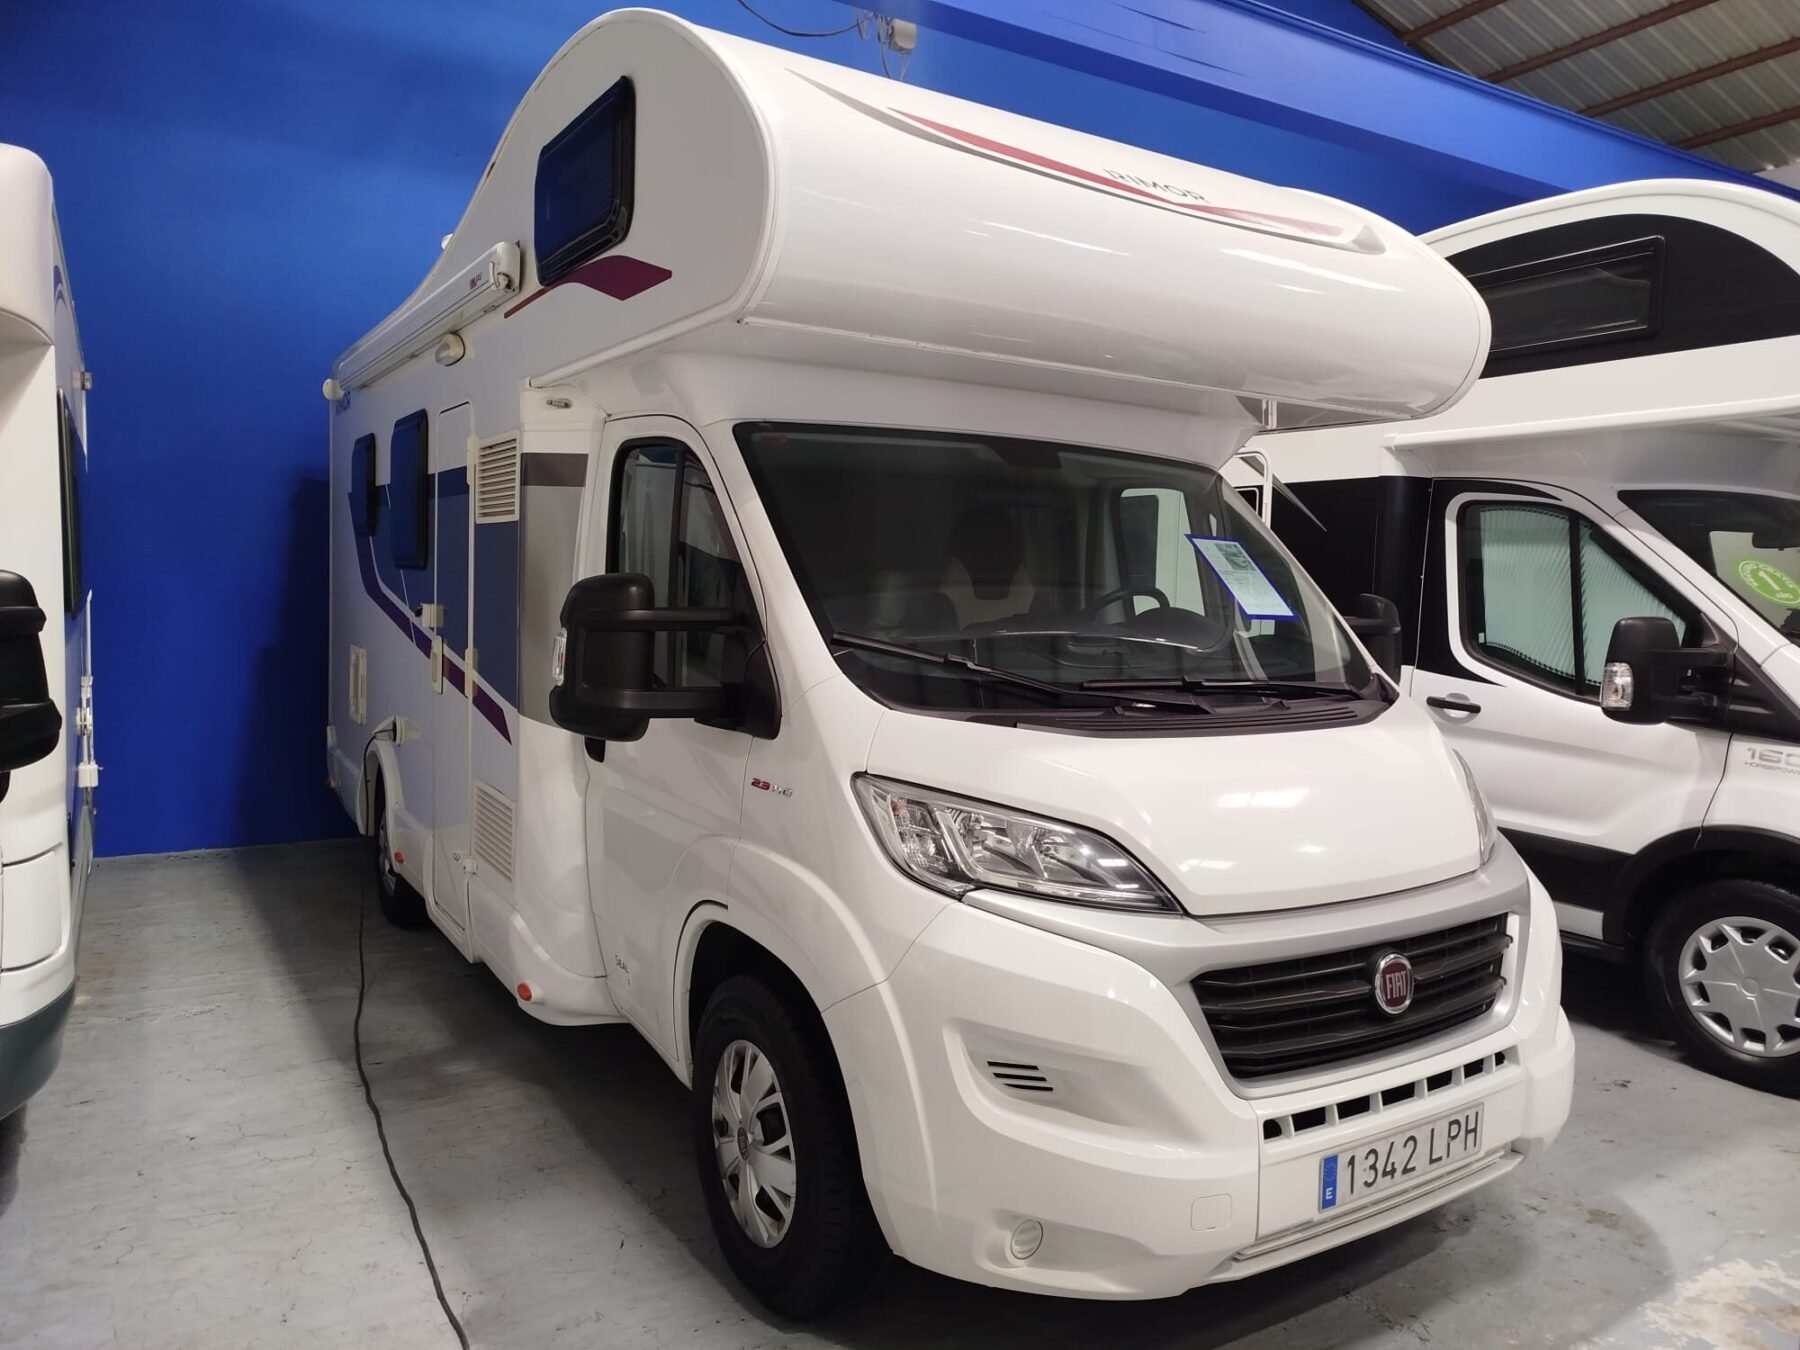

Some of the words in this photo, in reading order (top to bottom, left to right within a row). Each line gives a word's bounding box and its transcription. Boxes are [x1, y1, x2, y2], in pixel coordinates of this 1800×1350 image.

[1102, 168, 1211, 203] RIMOR
[1758, 571, 1781, 591] 1
[1385, 970, 1406, 1000] FIAT
[1347, 1134, 1418, 1194] 1342
[1429, 1111, 1479, 1166] LPH
[1325, 1187, 1333, 1200] E
